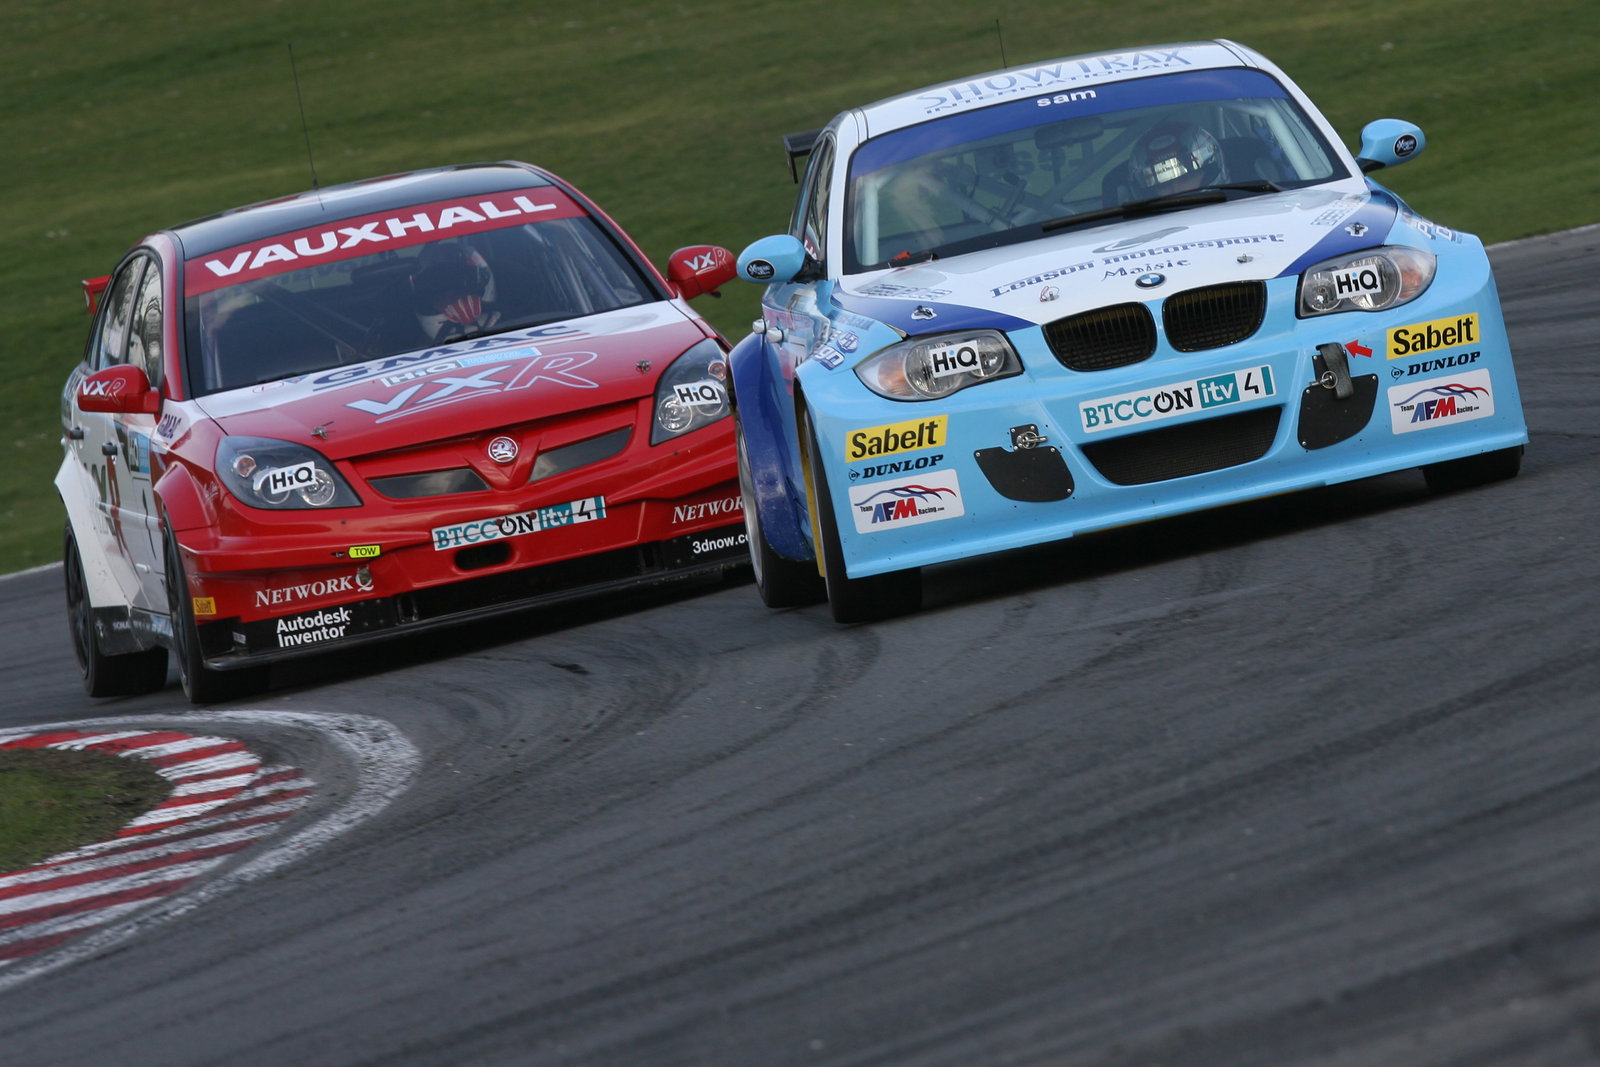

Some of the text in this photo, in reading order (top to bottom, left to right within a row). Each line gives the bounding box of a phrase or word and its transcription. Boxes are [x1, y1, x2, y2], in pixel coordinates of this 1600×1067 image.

[1037, 89, 1097, 107] sam
[204, 195, 557, 277] VAUXHALL
[683, 248, 727, 275] VXR
[1335, 268, 1378, 294] HiQ
[1393, 317, 1474, 355] Sabelt
[312, 325, 578, 387] GMAC
[931, 344, 979, 374] HiQ
[1407, 351, 1481, 376] DUNLOP
[345, 350, 599, 417] VXR
[389, 362, 457, 383] HiQ
[80, 377, 127, 400] VXR
[677, 385, 717, 402] HiQ
[1201, 381, 1234, 404] itv
[1244, 372, 1260, 394] 4
[1411, 396, 1457, 423] AFM
[851, 421, 939, 458] Sabelt
[271, 467, 313, 491] HiQ
[863, 455, 944, 479] DUNLOP
[541, 509, 572, 528] itv
[577, 500, 592, 520] 4
[860, 505, 873, 513] Team
[871, 498, 919, 524] AFM
[354, 547, 376, 556] TOW
[255, 575, 354, 608] NETWORK
[276, 607, 351, 634] Autodesk
[278, 625, 346, 648] Inventor
